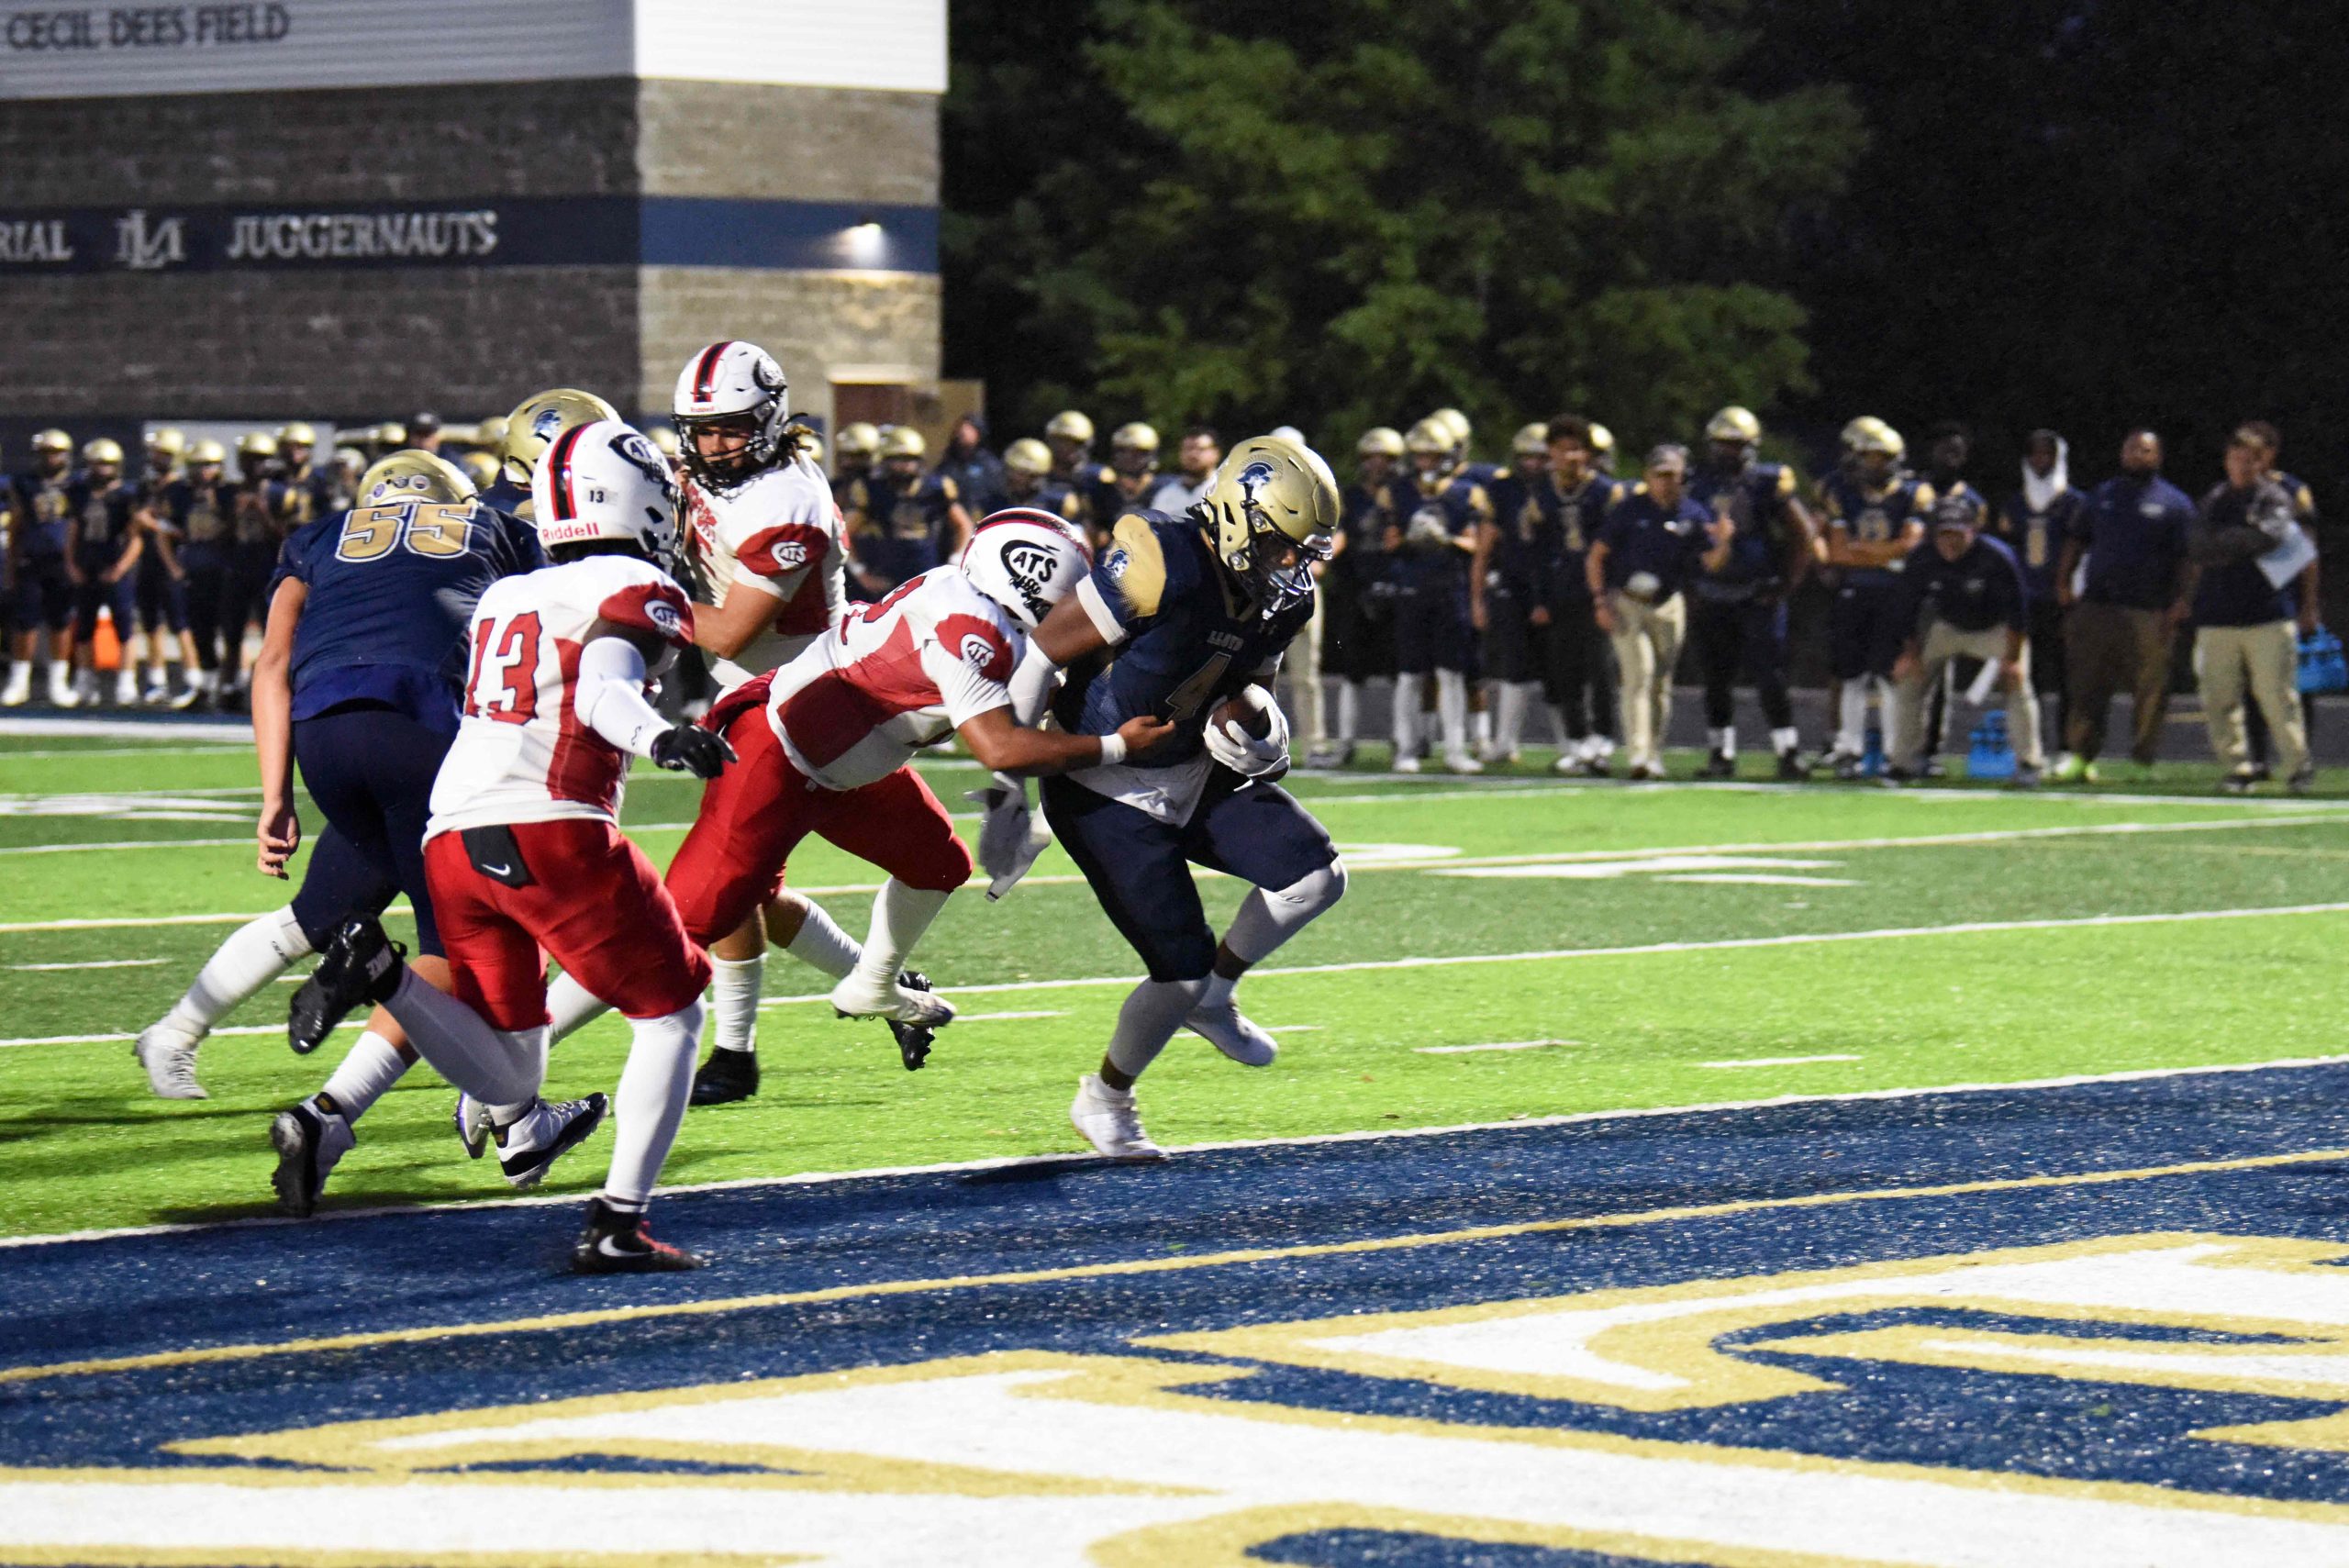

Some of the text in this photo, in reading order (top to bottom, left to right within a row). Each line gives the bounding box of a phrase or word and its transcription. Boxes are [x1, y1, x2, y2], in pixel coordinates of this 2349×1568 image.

[6, 2, 290, 49] CECIL DEES FIELD
[228, 211, 497, 258] JUGGERNAUTS
[589, 490, 604, 503] 13
[335, 503, 478, 562] 55
[542, 522, 600, 542] Riddell
[464, 610, 543, 726] 13
[1164, 651, 1231, 722] 4
